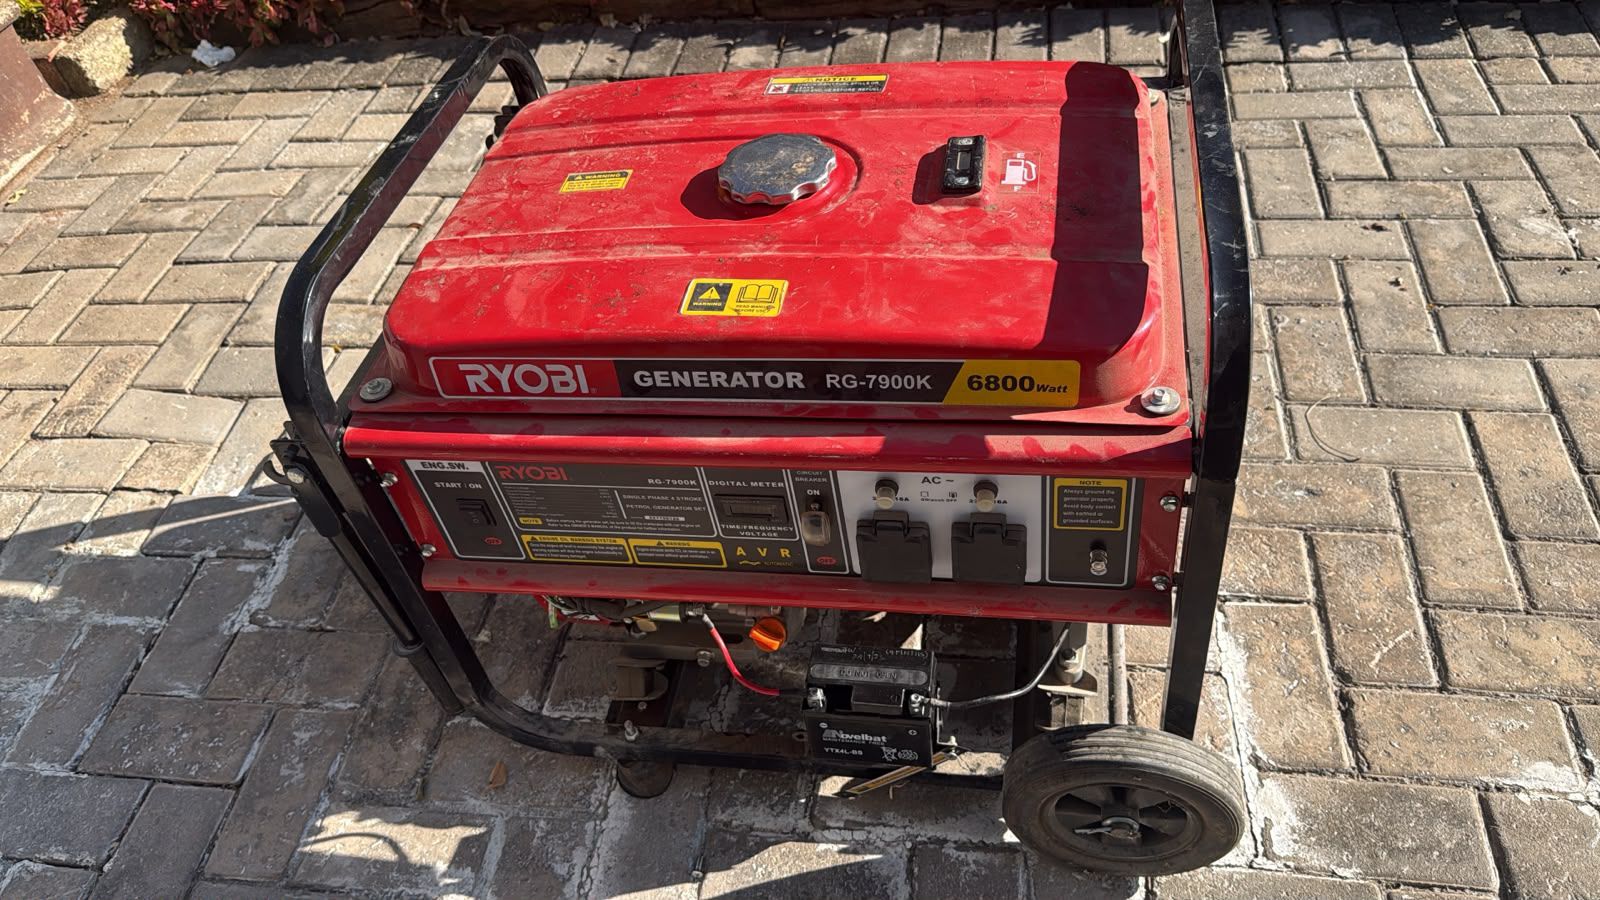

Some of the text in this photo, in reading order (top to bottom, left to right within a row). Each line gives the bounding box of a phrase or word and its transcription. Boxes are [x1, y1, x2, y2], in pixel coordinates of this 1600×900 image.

[457, 363, 590, 394] RYOBI
[633, 370, 932, 391] GENERATOR RG-7900K
[420, 461, 470, 471] ENG.SW.
[495, 465, 568, 481] RYOBI
[433, 481, 462, 489] START
[647, 478, 697, 486] RG-7900K
[921, 476, 941, 485] AC
